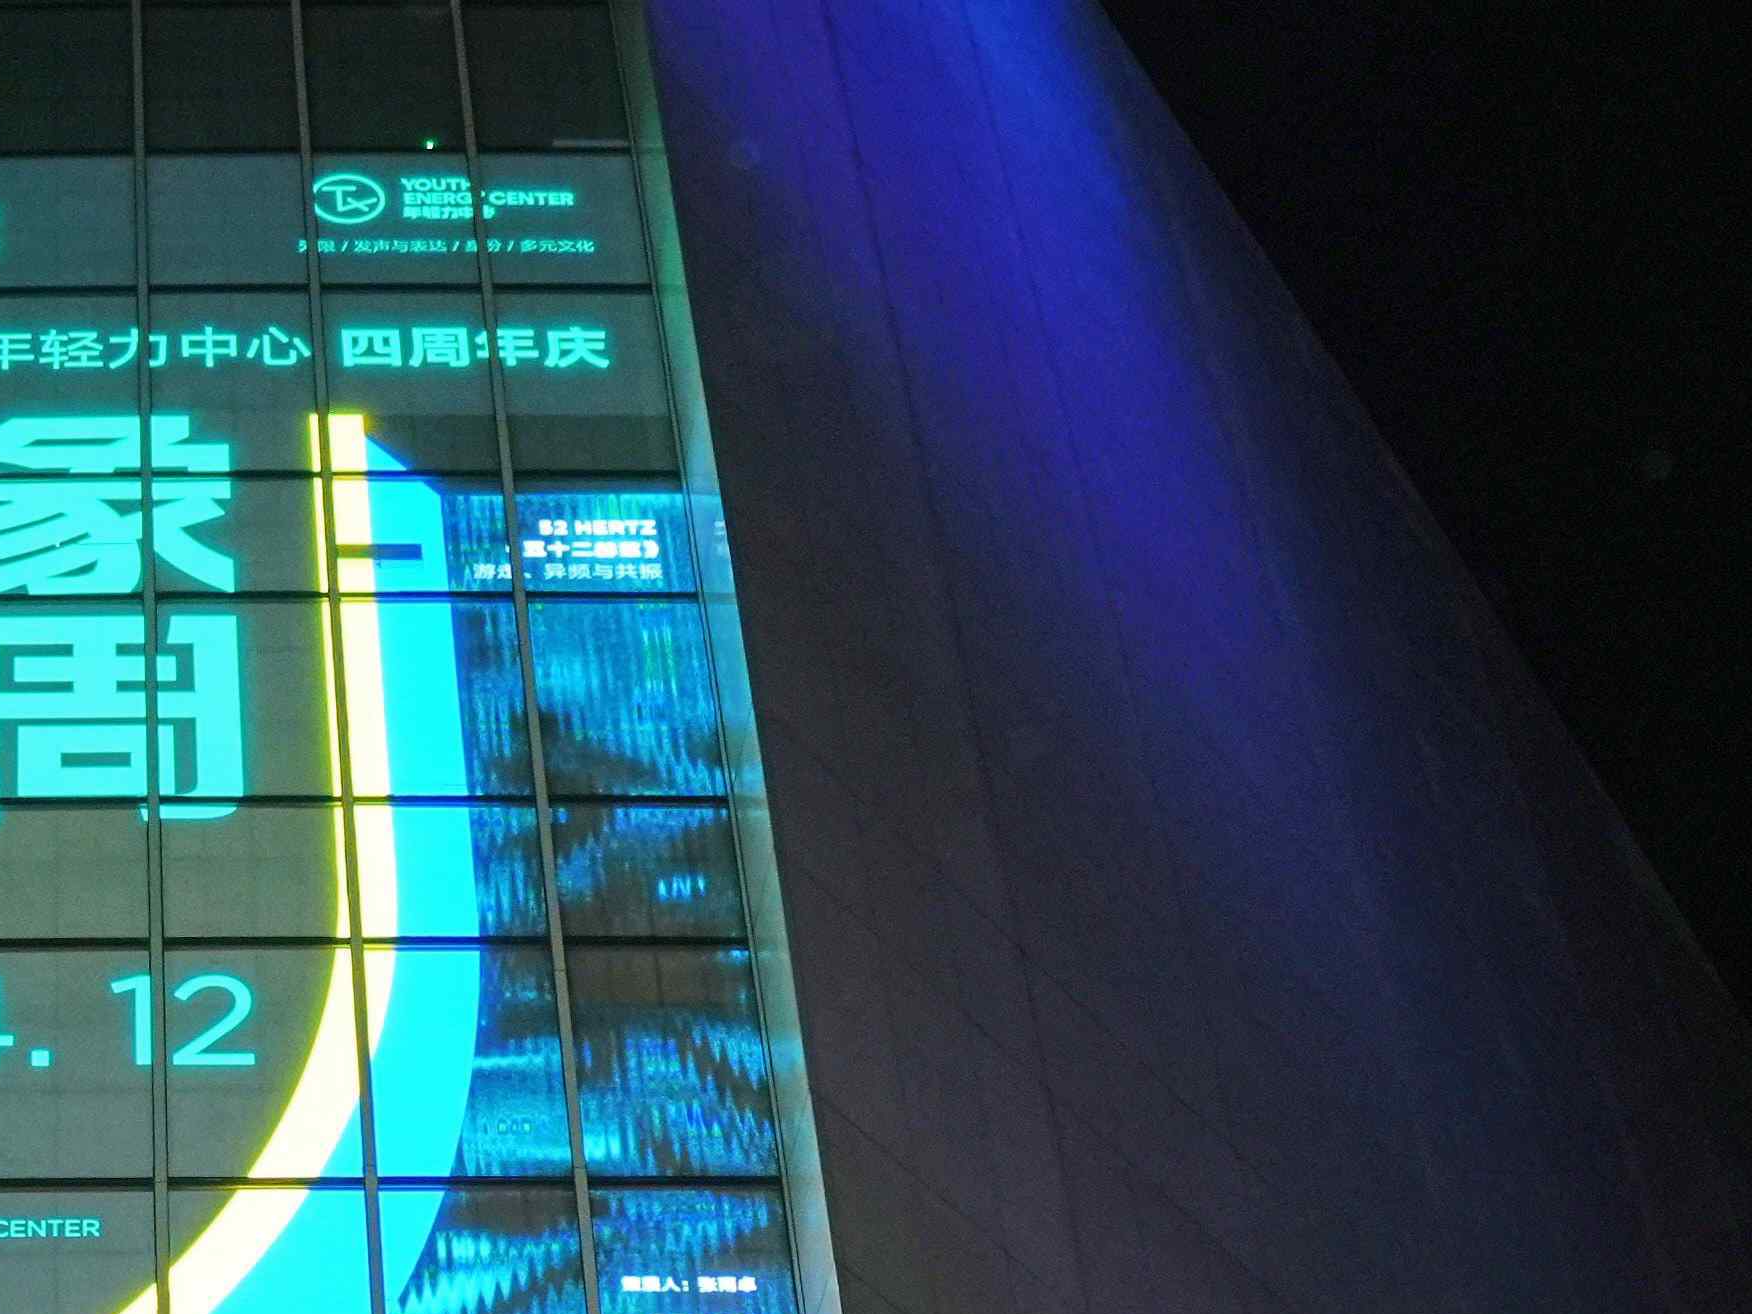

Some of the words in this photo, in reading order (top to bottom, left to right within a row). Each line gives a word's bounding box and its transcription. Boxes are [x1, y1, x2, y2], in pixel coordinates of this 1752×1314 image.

[400, 177, 471, 191] YOUTH
[403, 191, 486, 206] ENERG
[489, 191, 574, 206] CENTER
[341, 326, 610, 370] 四周年庆
[111, 974, 256, 1068] 12
